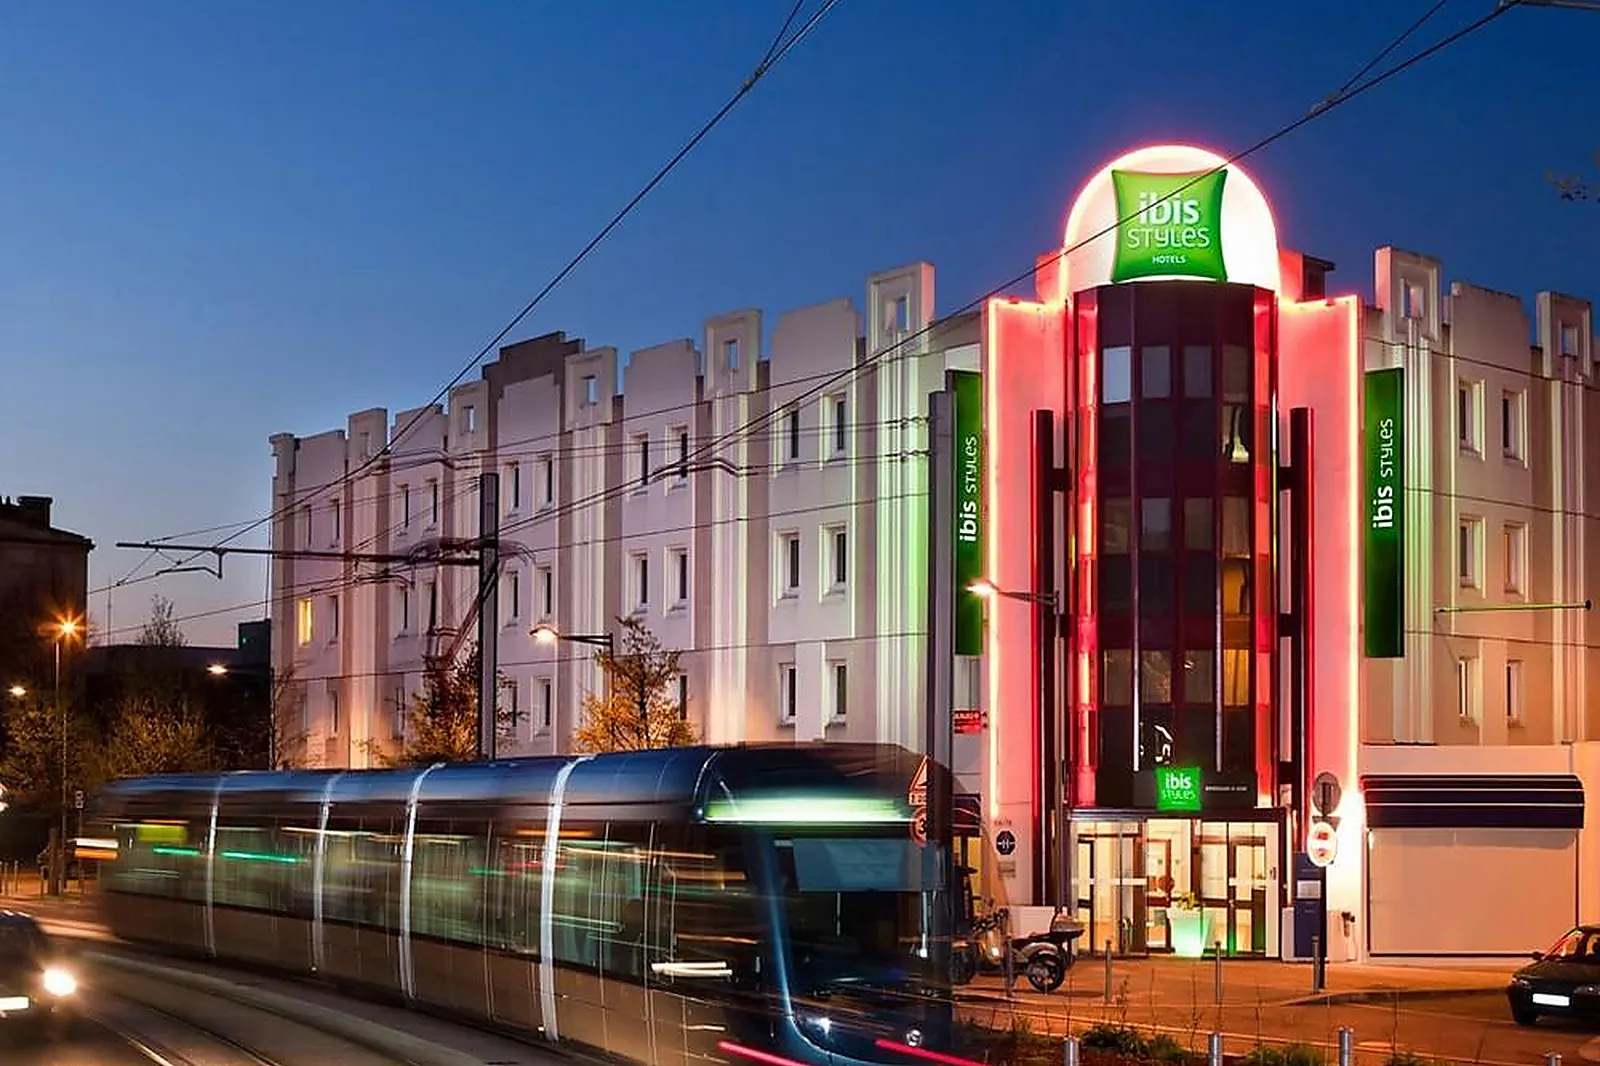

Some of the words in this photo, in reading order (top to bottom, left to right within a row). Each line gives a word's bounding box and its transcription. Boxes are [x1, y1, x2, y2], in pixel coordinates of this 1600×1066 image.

[1139, 191, 1200, 226] ibis
[1152, 255, 1186, 264] HOTELS
[959, 500, 977, 542] ibis
[1373, 486, 1393, 528] ibis
[1165, 772, 1192, 790] ibis
